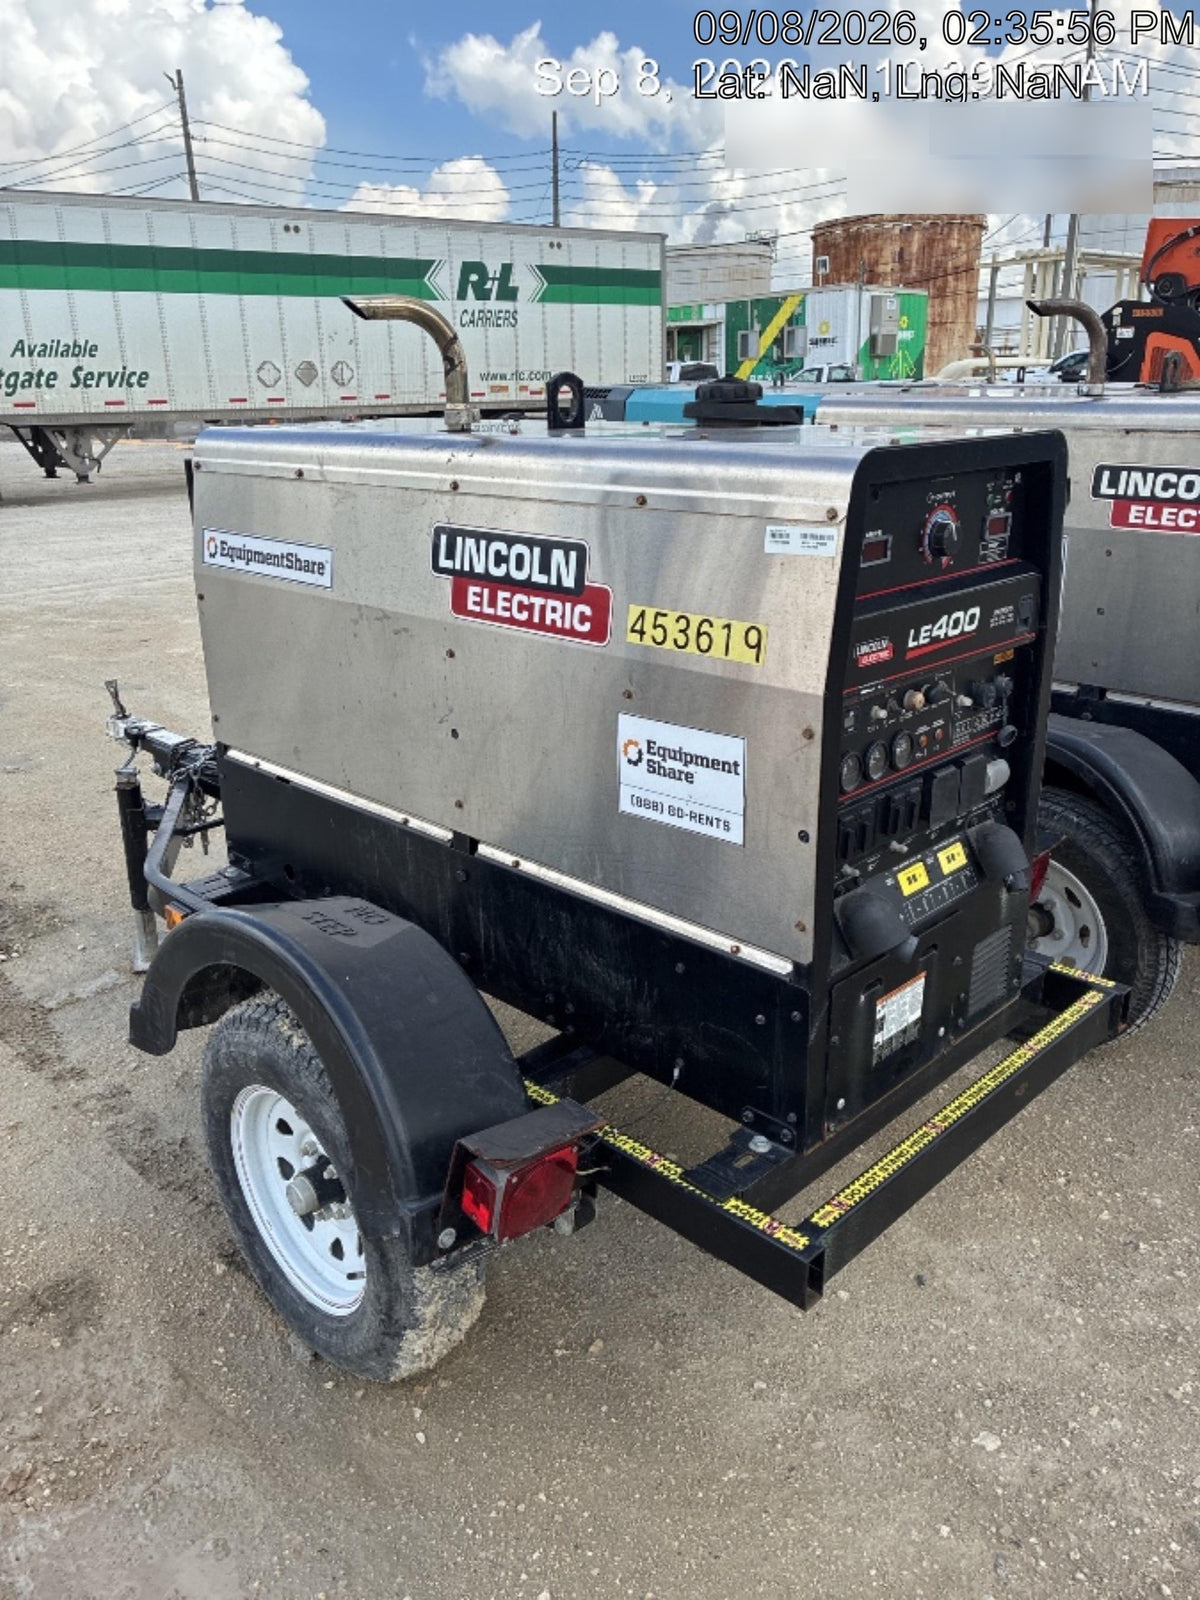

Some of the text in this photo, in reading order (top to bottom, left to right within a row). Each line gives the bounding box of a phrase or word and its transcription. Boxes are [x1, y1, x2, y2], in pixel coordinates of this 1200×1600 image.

[459, 308, 519, 328] CARRIERS
[10, 338, 99, 358] Available
[70, 365, 150, 389] Service
[1099, 469, 1200, 501] LINCO
[1128, 504, 1200, 528] ELEC
[219, 540, 326, 577] EquipmentShare
[437, 533, 578, 590] LINCOLN
[466, 585, 593, 633] ELECTRIC
[907, 605, 981, 649] LE400
[628, 608, 764, 664] 453619
[646, 738, 741, 777] Equipment
[646, 758, 696, 785] Share
[630, 793, 732, 833] (888) 80-RENTS
